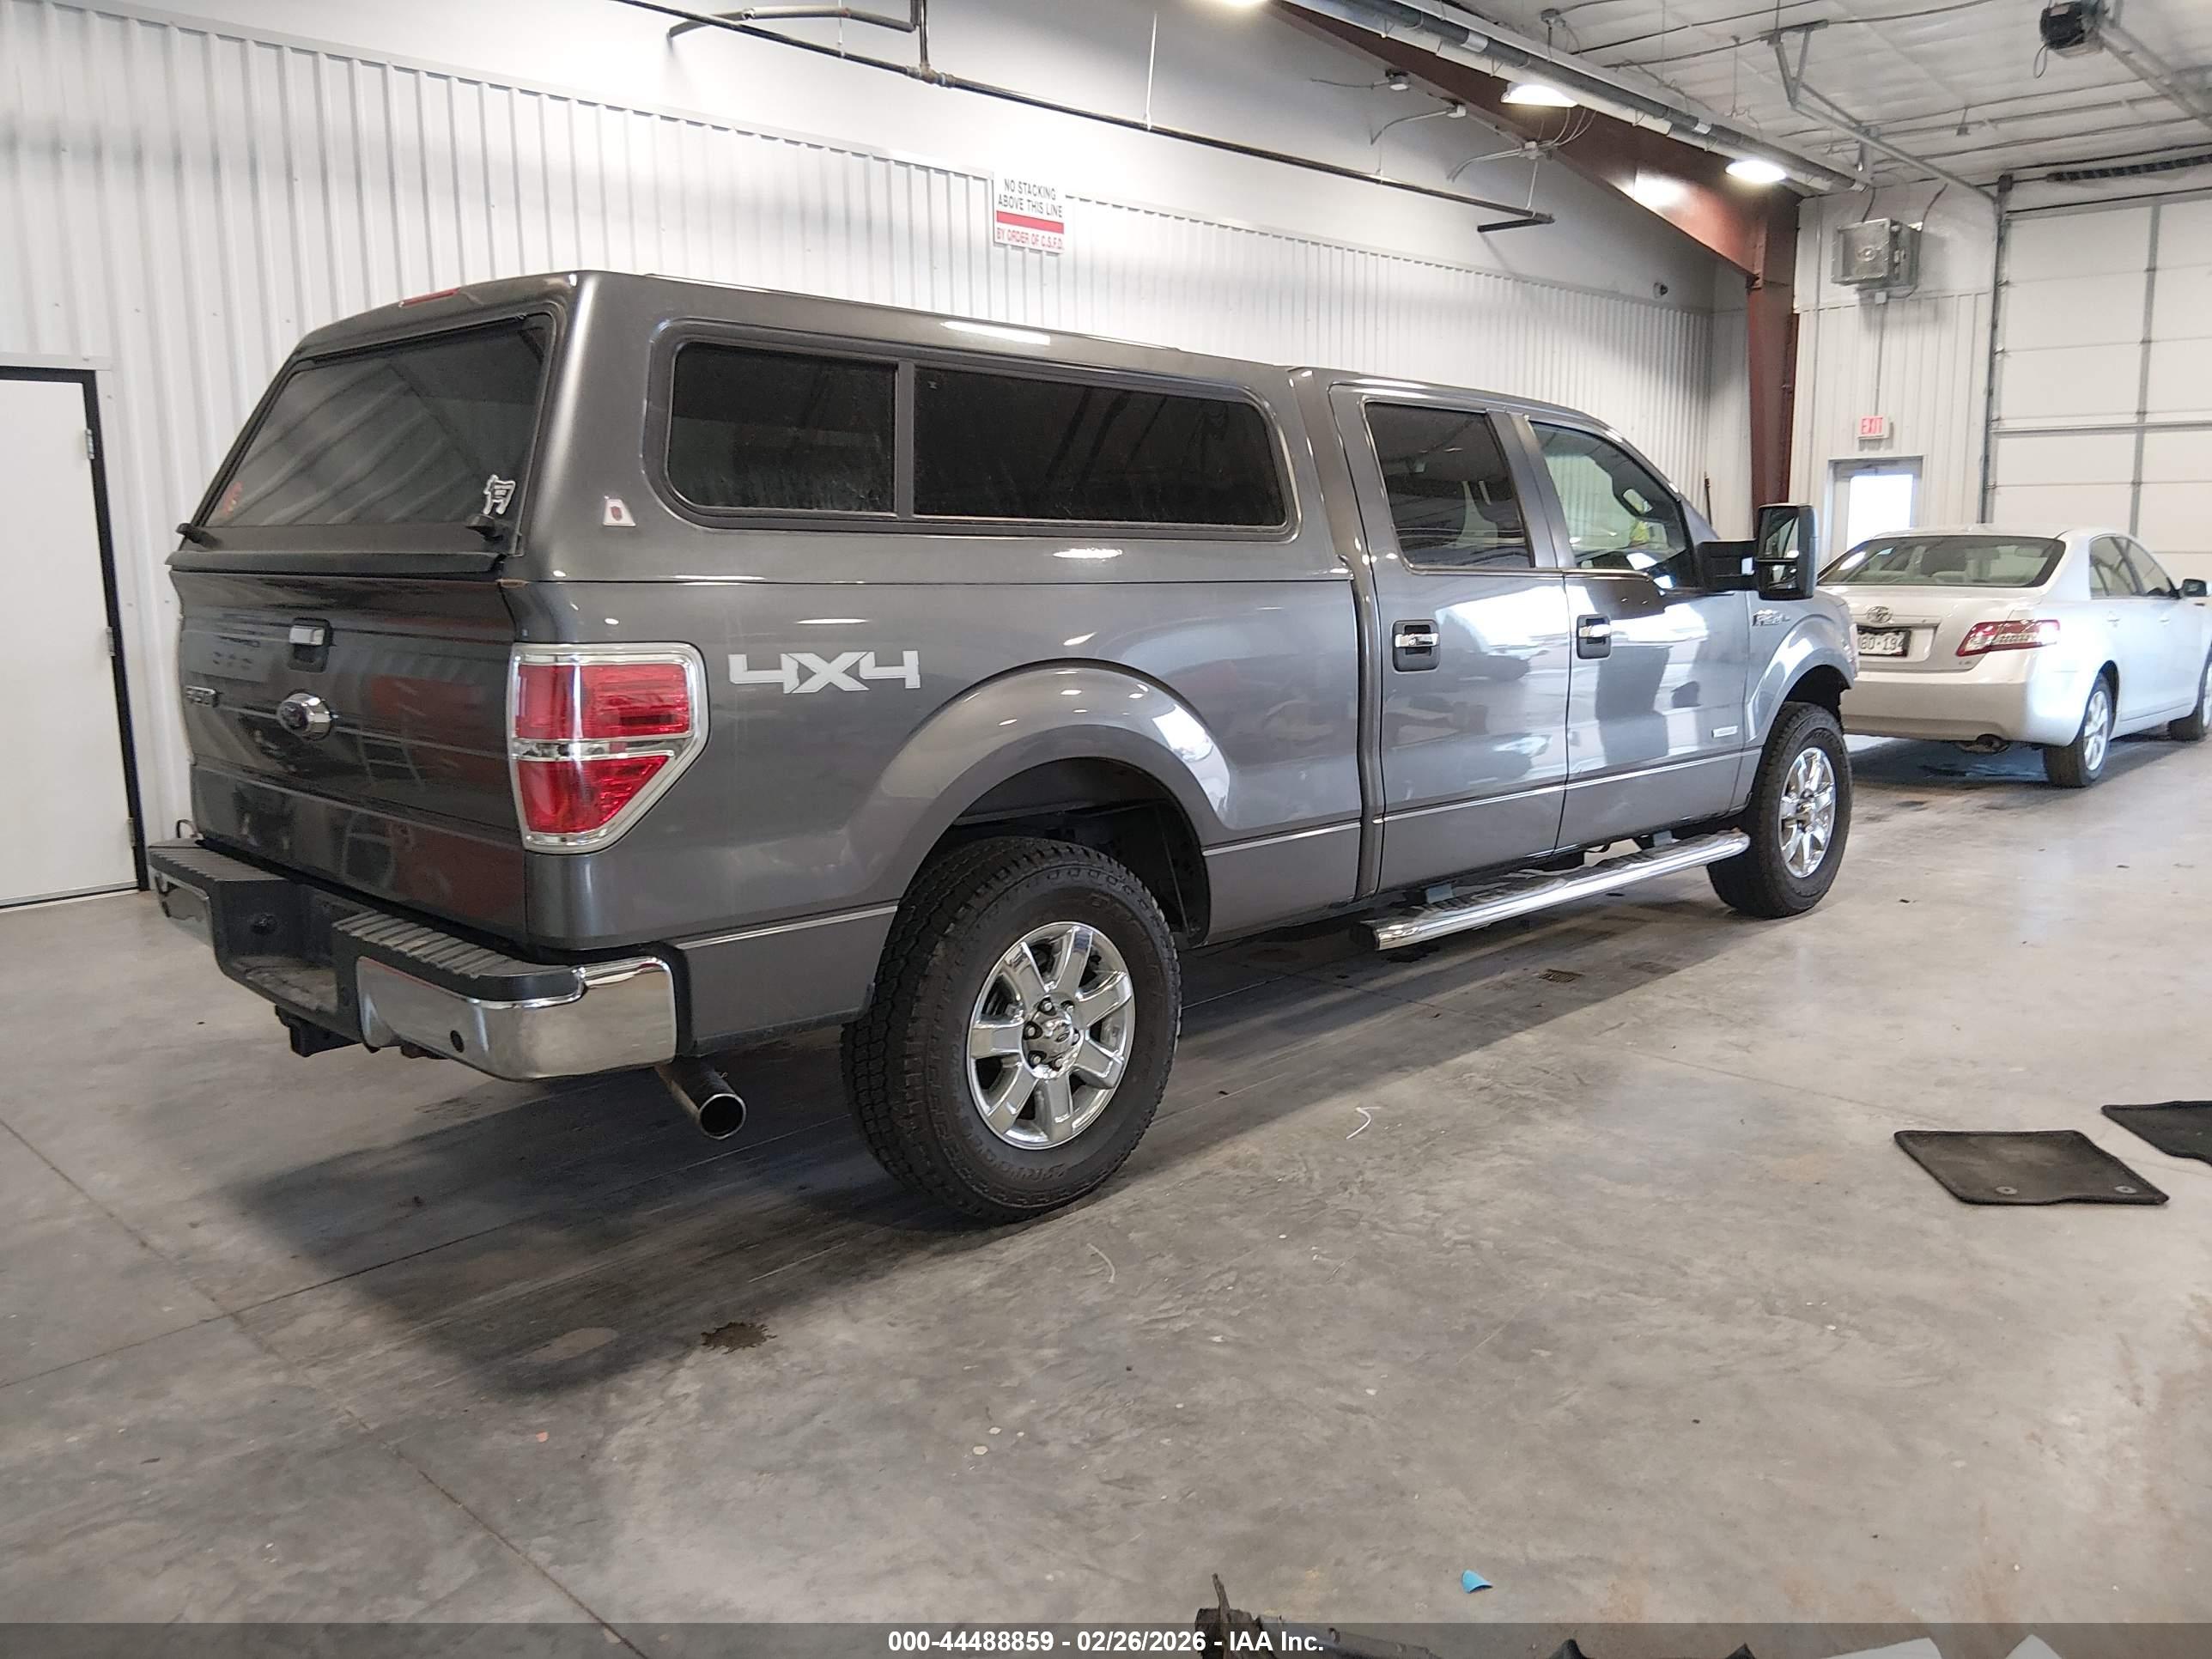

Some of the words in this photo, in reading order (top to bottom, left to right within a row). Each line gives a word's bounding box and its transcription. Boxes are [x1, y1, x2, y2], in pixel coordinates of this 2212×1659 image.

[1004, 179, 1016, 193] NO
[1018, 181, 1056, 201] STACKING
[998, 194, 1024, 211] ABOVE
[1026, 198, 1044, 215] THIS
[1046, 204, 1063, 218] LINE
[996, 227, 1005, 240] BY
[1007, 228, 1030, 244] ORDER
[1031, 233, 1040, 246] OF
[1861, 417, 1883, 434] EXIT
